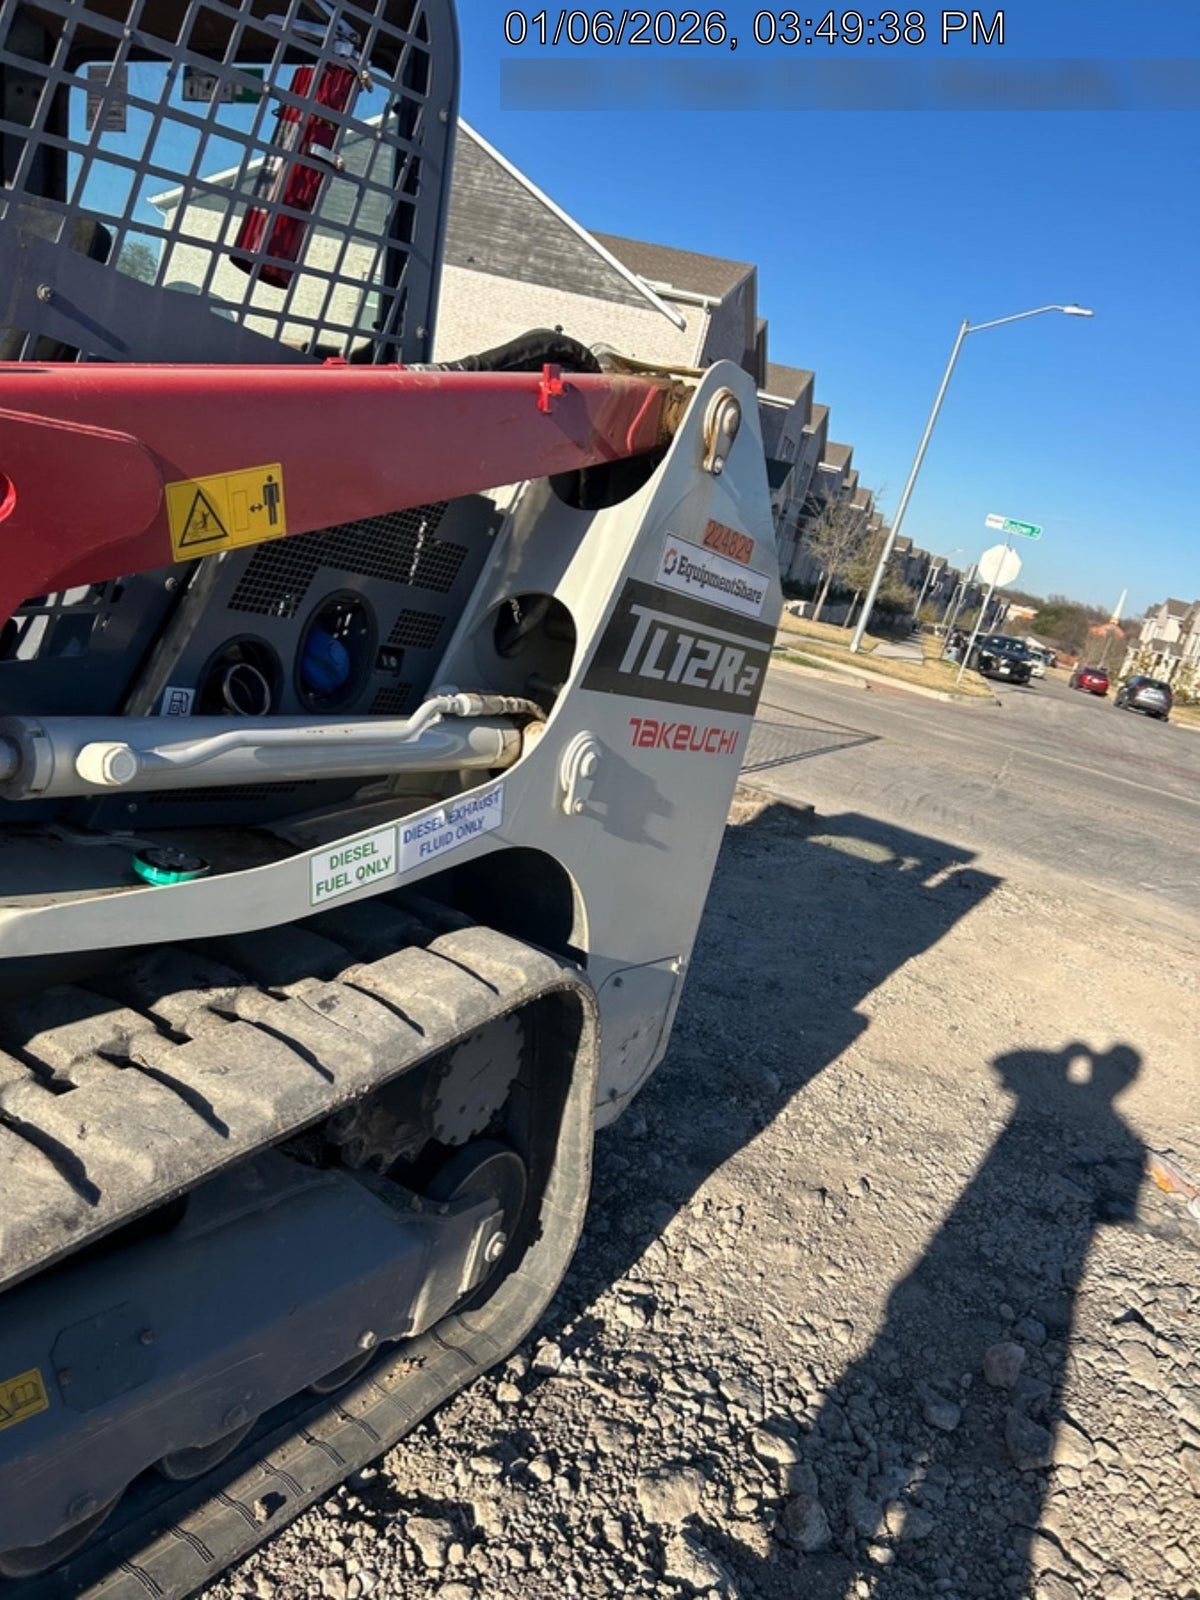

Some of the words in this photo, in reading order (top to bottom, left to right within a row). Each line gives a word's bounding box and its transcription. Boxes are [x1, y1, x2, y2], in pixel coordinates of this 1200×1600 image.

[676, 554, 763, 606] EquipmentShare
[618, 603, 770, 697] TL12R2
[629, 717, 739, 754] TAKEUCHI
[403, 815, 446, 845] DIESEL
[447, 789, 501, 824] EXHAUST
[419, 831, 454, 857] FLUID
[456, 816, 485, 839] ONLY
[329, 841, 379, 870] DIESEL
[315, 873, 352, 897] FUEL
[355, 856, 392, 881] ONLY
